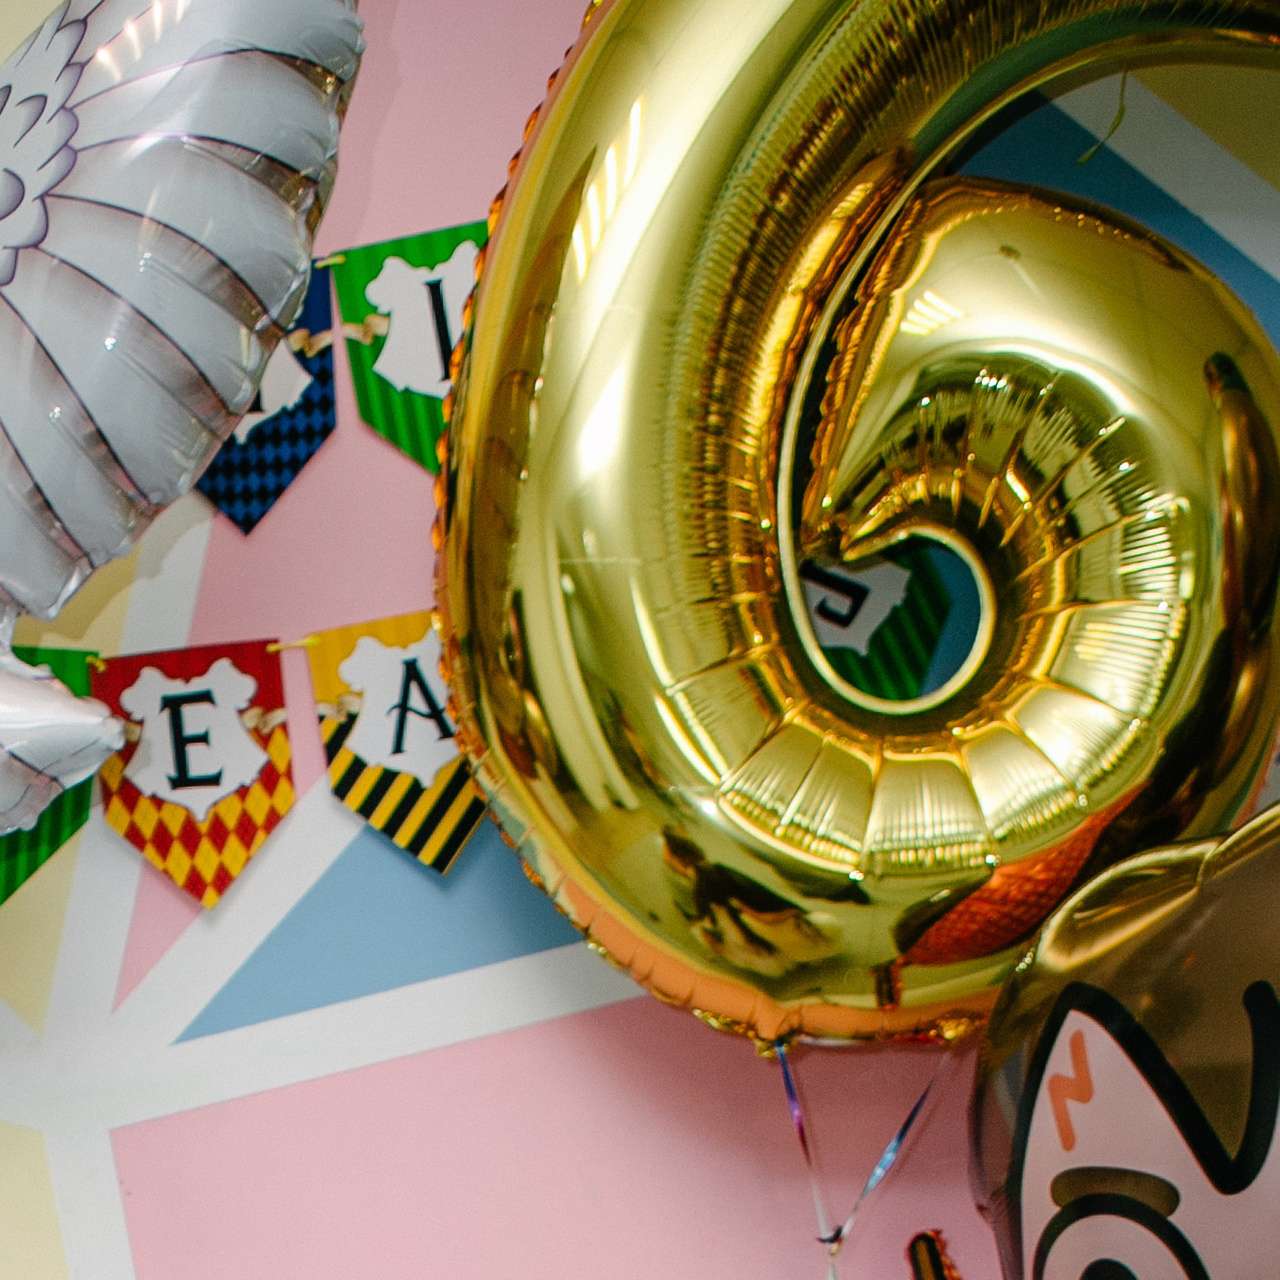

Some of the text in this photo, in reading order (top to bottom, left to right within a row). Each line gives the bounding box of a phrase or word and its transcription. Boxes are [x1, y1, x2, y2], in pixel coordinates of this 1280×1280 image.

[159, 690, 223, 790] E
[386, 658, 455, 755] A
[434, 0, 1280, 1046] 6
